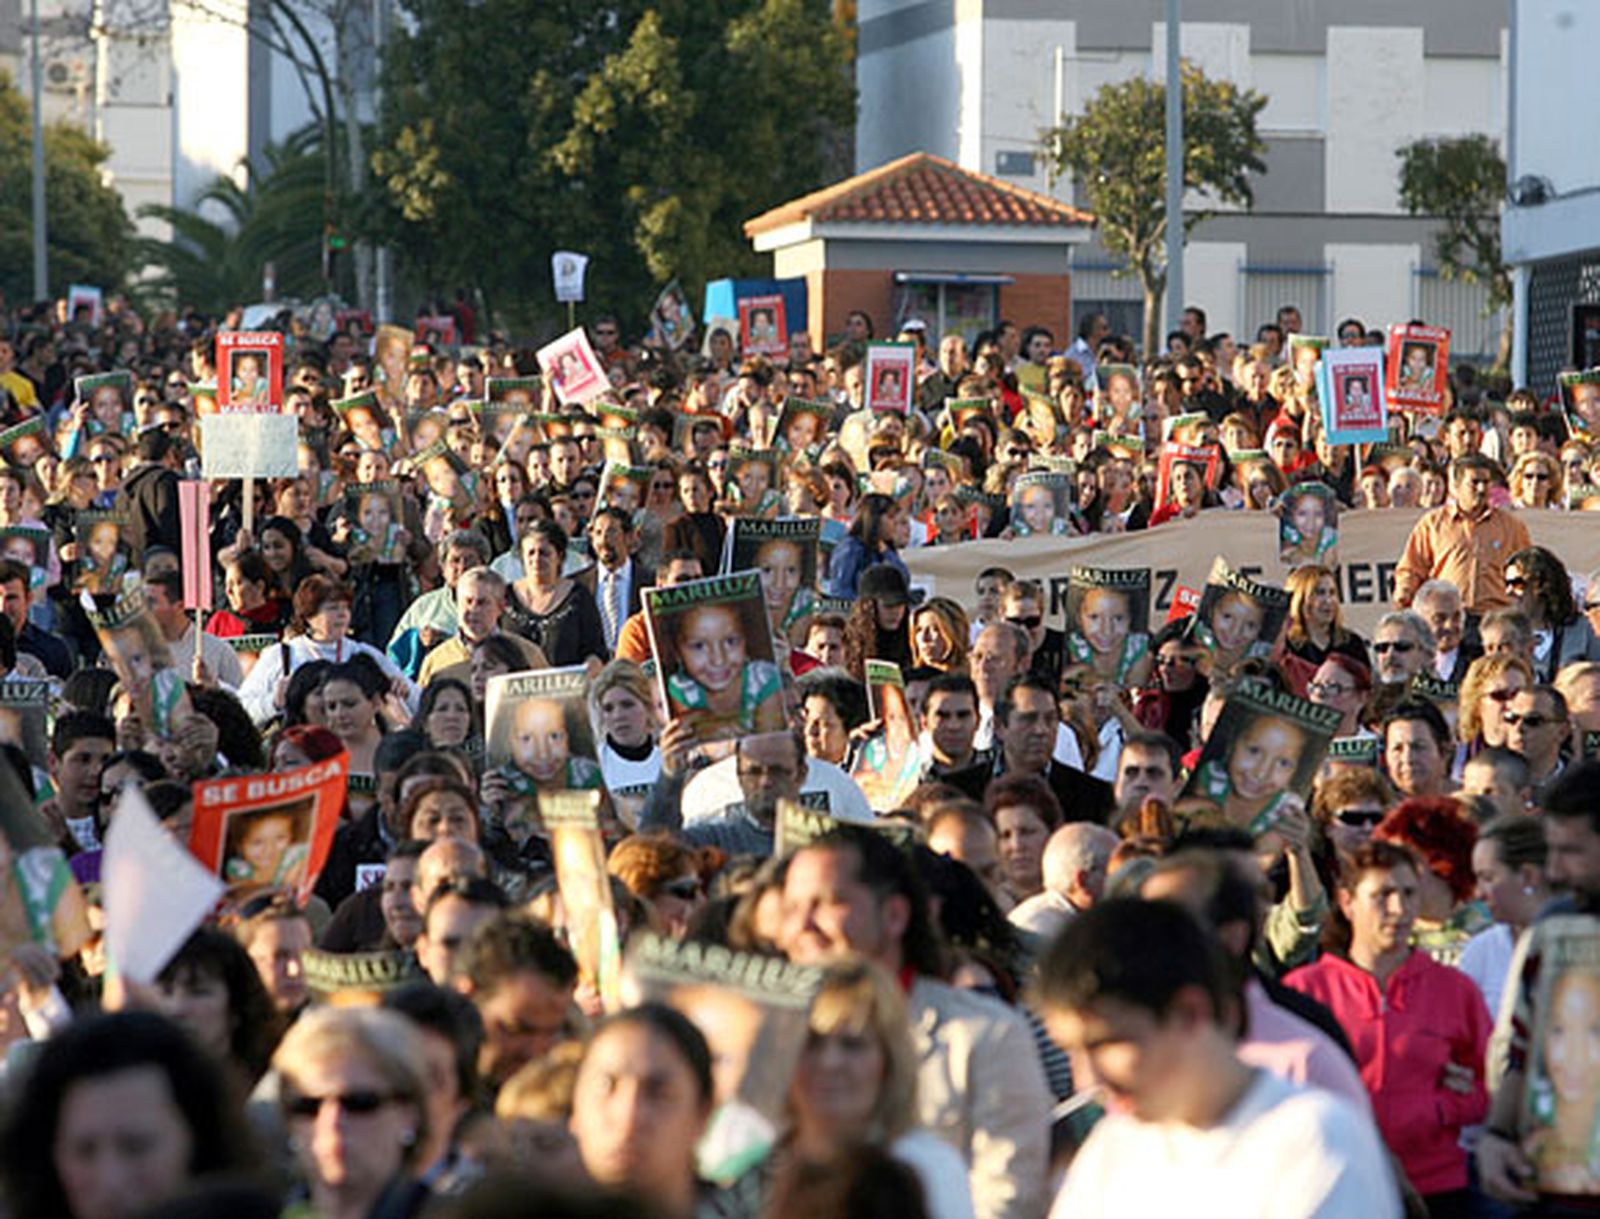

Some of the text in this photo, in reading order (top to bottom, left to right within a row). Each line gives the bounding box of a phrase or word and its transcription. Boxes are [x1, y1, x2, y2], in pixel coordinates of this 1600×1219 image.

[739, 519, 819, 535] MARILUZ
[1071, 565, 1148, 586] MARILUZ
[652, 577, 758, 608] MARILUZ
[1237, 677, 1344, 730] MARILUZ
[202, 762, 342, 808] SE BUSCA
